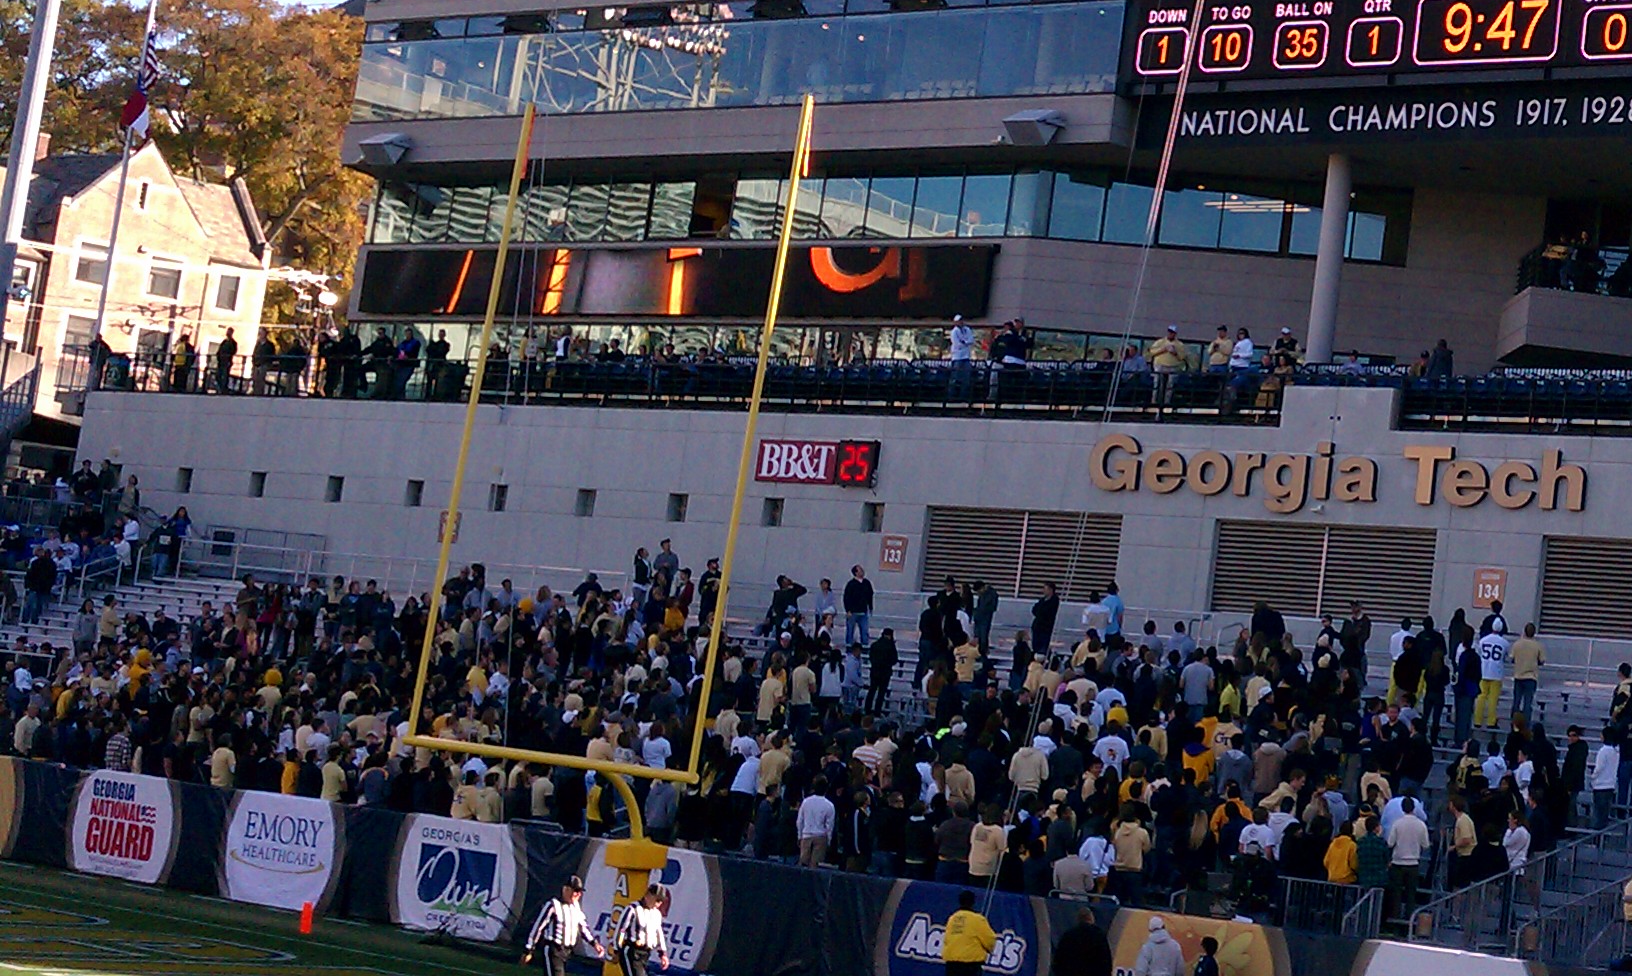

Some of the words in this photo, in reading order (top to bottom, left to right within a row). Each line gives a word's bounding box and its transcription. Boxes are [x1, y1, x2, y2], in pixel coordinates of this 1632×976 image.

[1148, 8, 1188, 24] DOWN
[1210, 6, 1229, 21] TO
[1230, 5, 1252, 20] GO
[1275, 3, 1310, 18] BALL
[1313, 1, 1334, 16] ON
[1367, 25, 1381, 56] 1
[1442, 0, 1550, 55] 9:47
[1603, 13, 1628, 51] 0
[1157, 35, 1169, 64] 1
[1211, 32, 1242, 62] 10
[1284, 28, 1319, 58] 35
[1180, 108, 1311, 137] NATIONAL
[1328, 101, 1497, 132] CHAMPIONS
[758, 442, 836, 480] BB&T
[840, 445, 870, 482] 25
[1089, 432, 1378, 514] Georgia
[1403, 444, 1588, 512] Tech
[883, 549, 902, 563] 133
[1478, 583, 1500, 599] 134
[1481, 644, 1503, 662] 56
[92, 778, 136, 802] GEORGIA
[89, 797, 142, 823] NATIONAL
[85, 816, 155, 861] GUARD
[243, 810, 325, 849] EMORY
[241, 843, 317, 867] HEALTHCARE
[416, 846, 495, 911] Own
